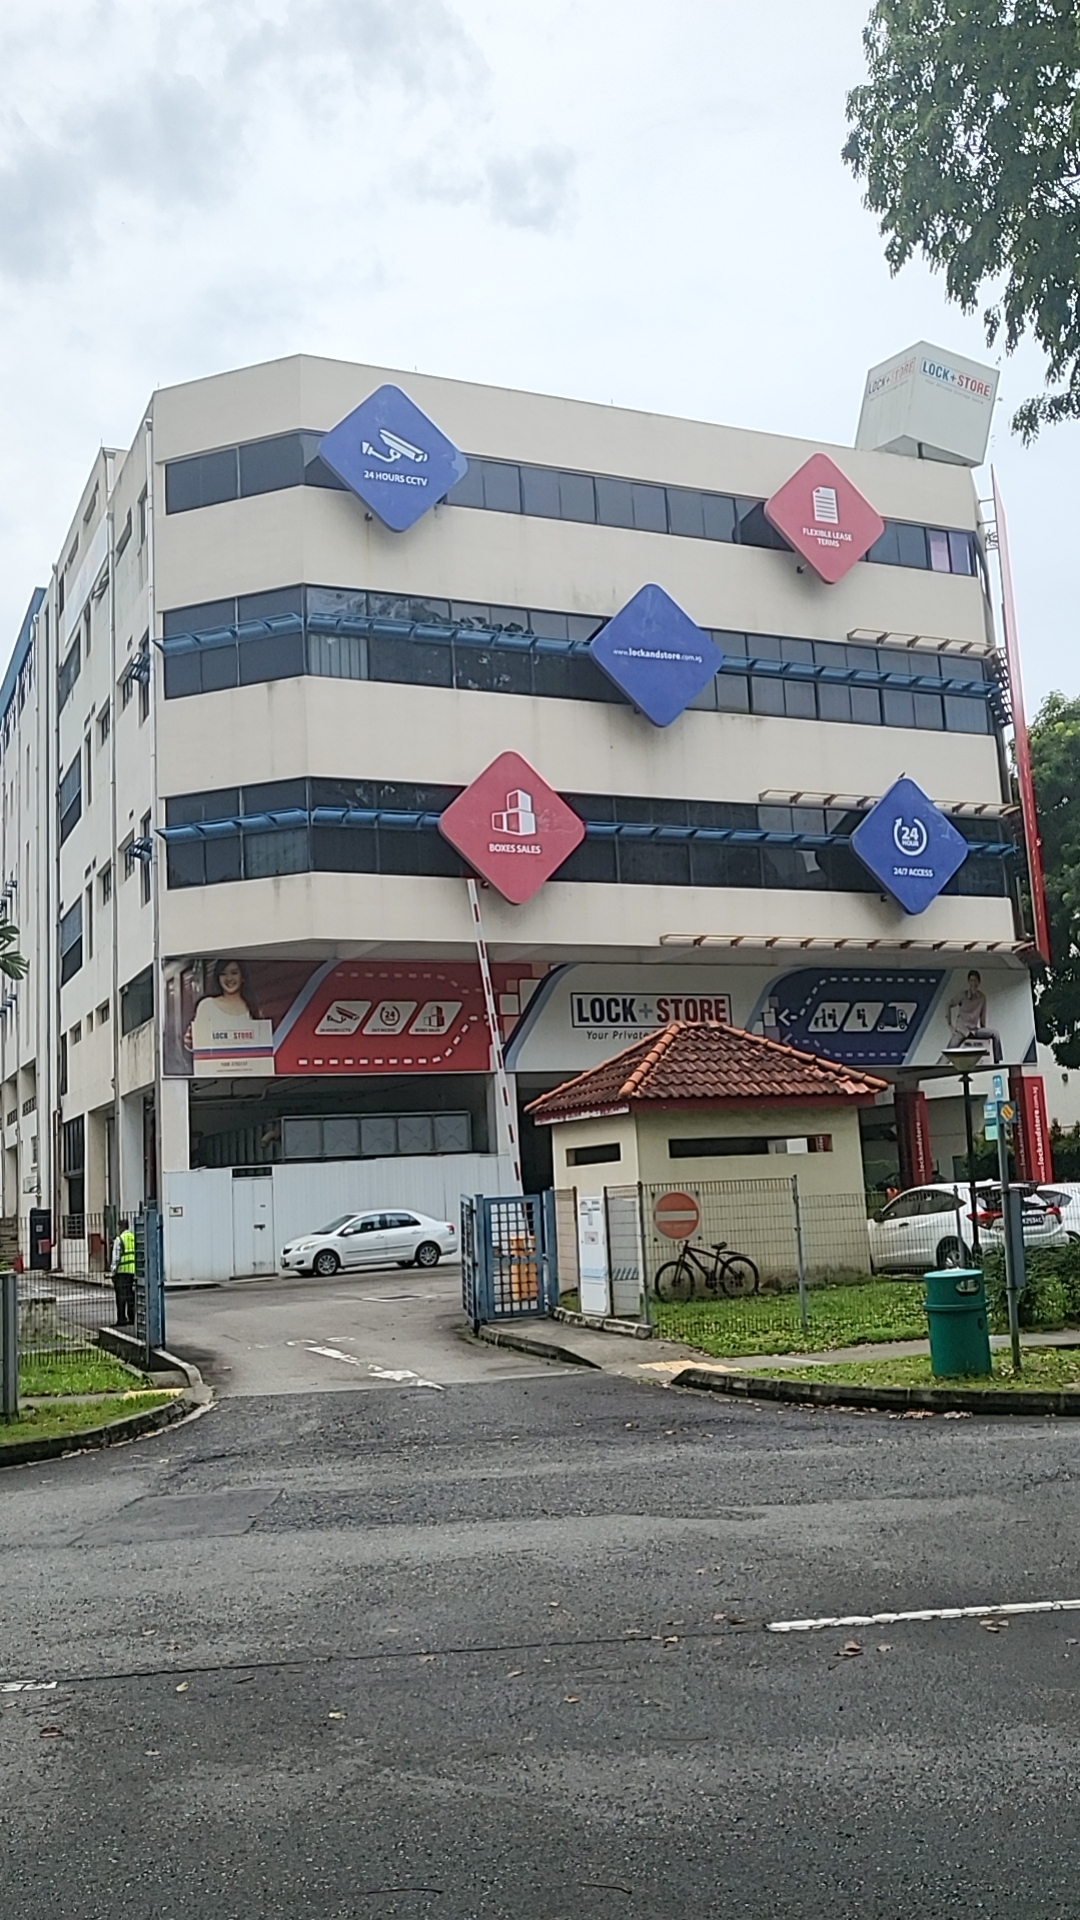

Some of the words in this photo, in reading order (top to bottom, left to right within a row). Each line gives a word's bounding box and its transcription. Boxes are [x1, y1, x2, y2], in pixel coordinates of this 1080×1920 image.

[364, 470, 374, 479] 24
[375, 471, 405, 483] HOURS
[405, 475, 428, 486] CCTV
[802, 527, 832, 539] FLEXIBLE
[832, 531, 853, 542] LEASE
[816, 537, 840, 548] TERMS
[613, 647, 703, 663] www.lockandstore.com.sg
[901, 826, 919, 840] 24
[489, 843, 516, 853] BOXES
[516, 844, 541, 854] SALES
[893, 867, 908, 876] 24/7
[908, 868, 934, 877] ACCESS
[384, 1010, 396, 1019] 24
[586, 1030, 609, 1040] Your
